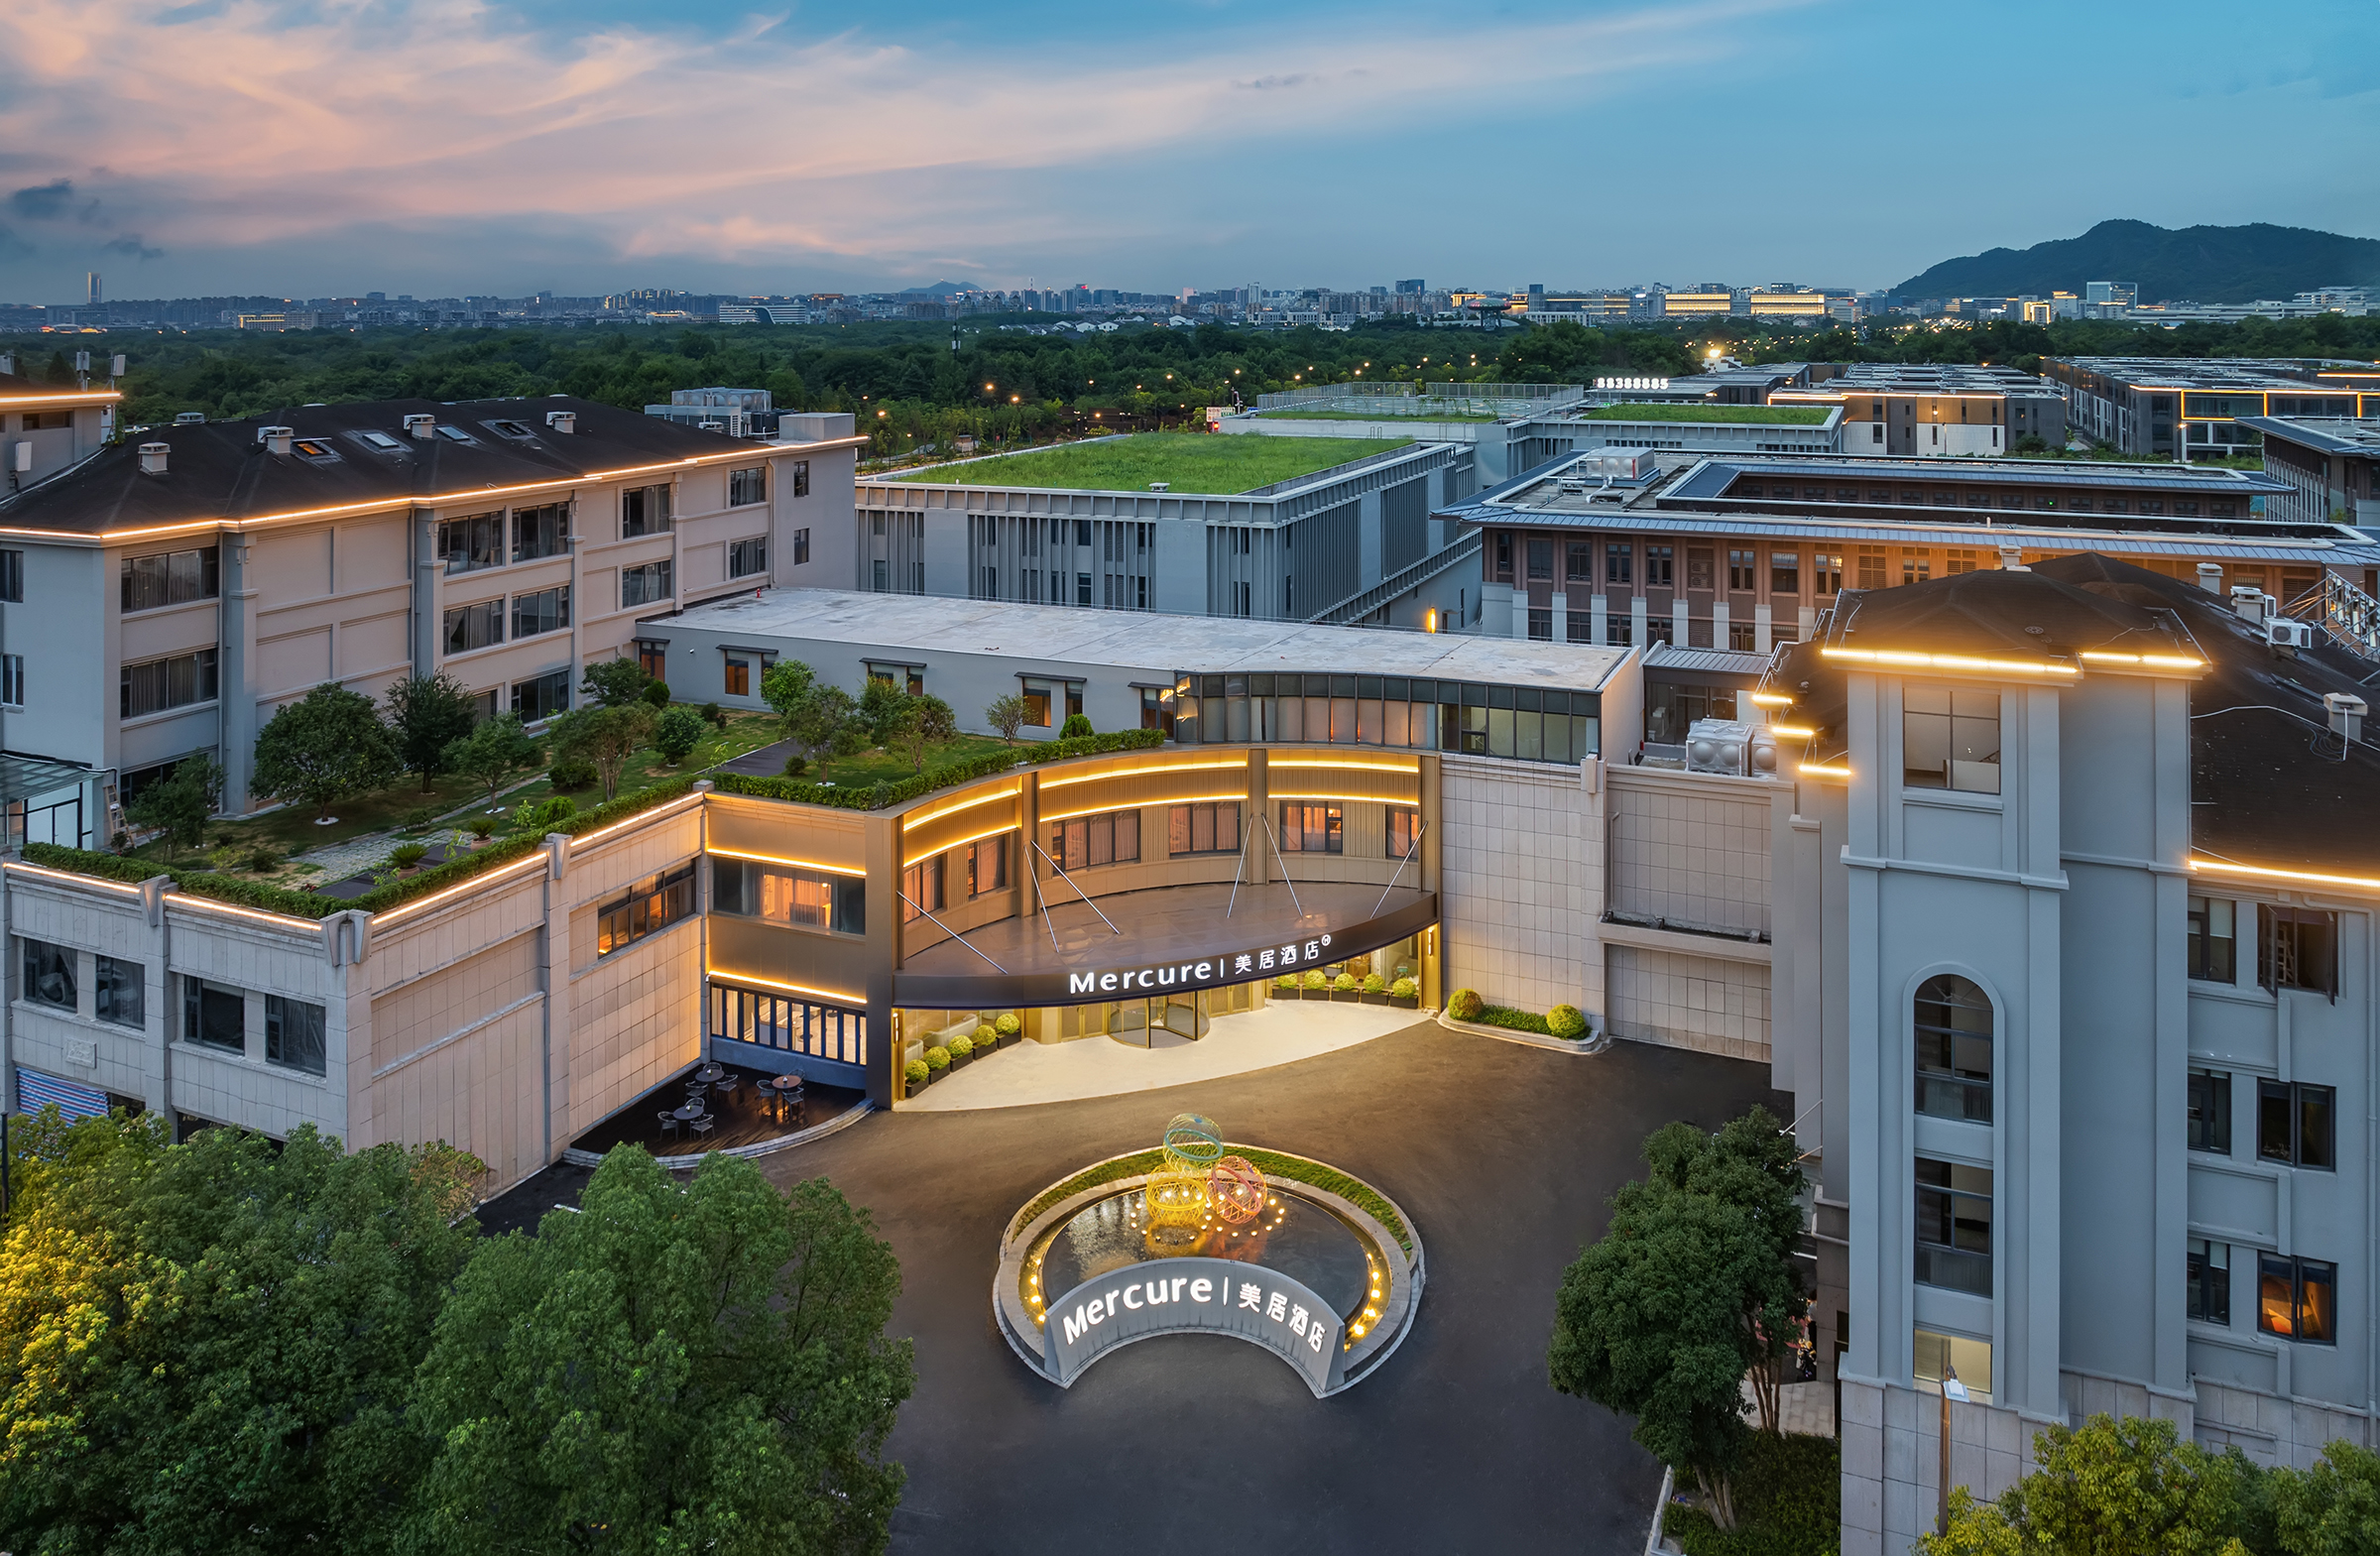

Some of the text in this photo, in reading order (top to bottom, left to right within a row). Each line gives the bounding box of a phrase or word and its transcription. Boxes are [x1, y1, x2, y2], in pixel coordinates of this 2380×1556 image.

[1070, 962, 1212, 995] Mercure
[1235, 940, 1320, 975] 美居酒店
[1062, 1277, 1326, 1353] Mercure 美居酒店
